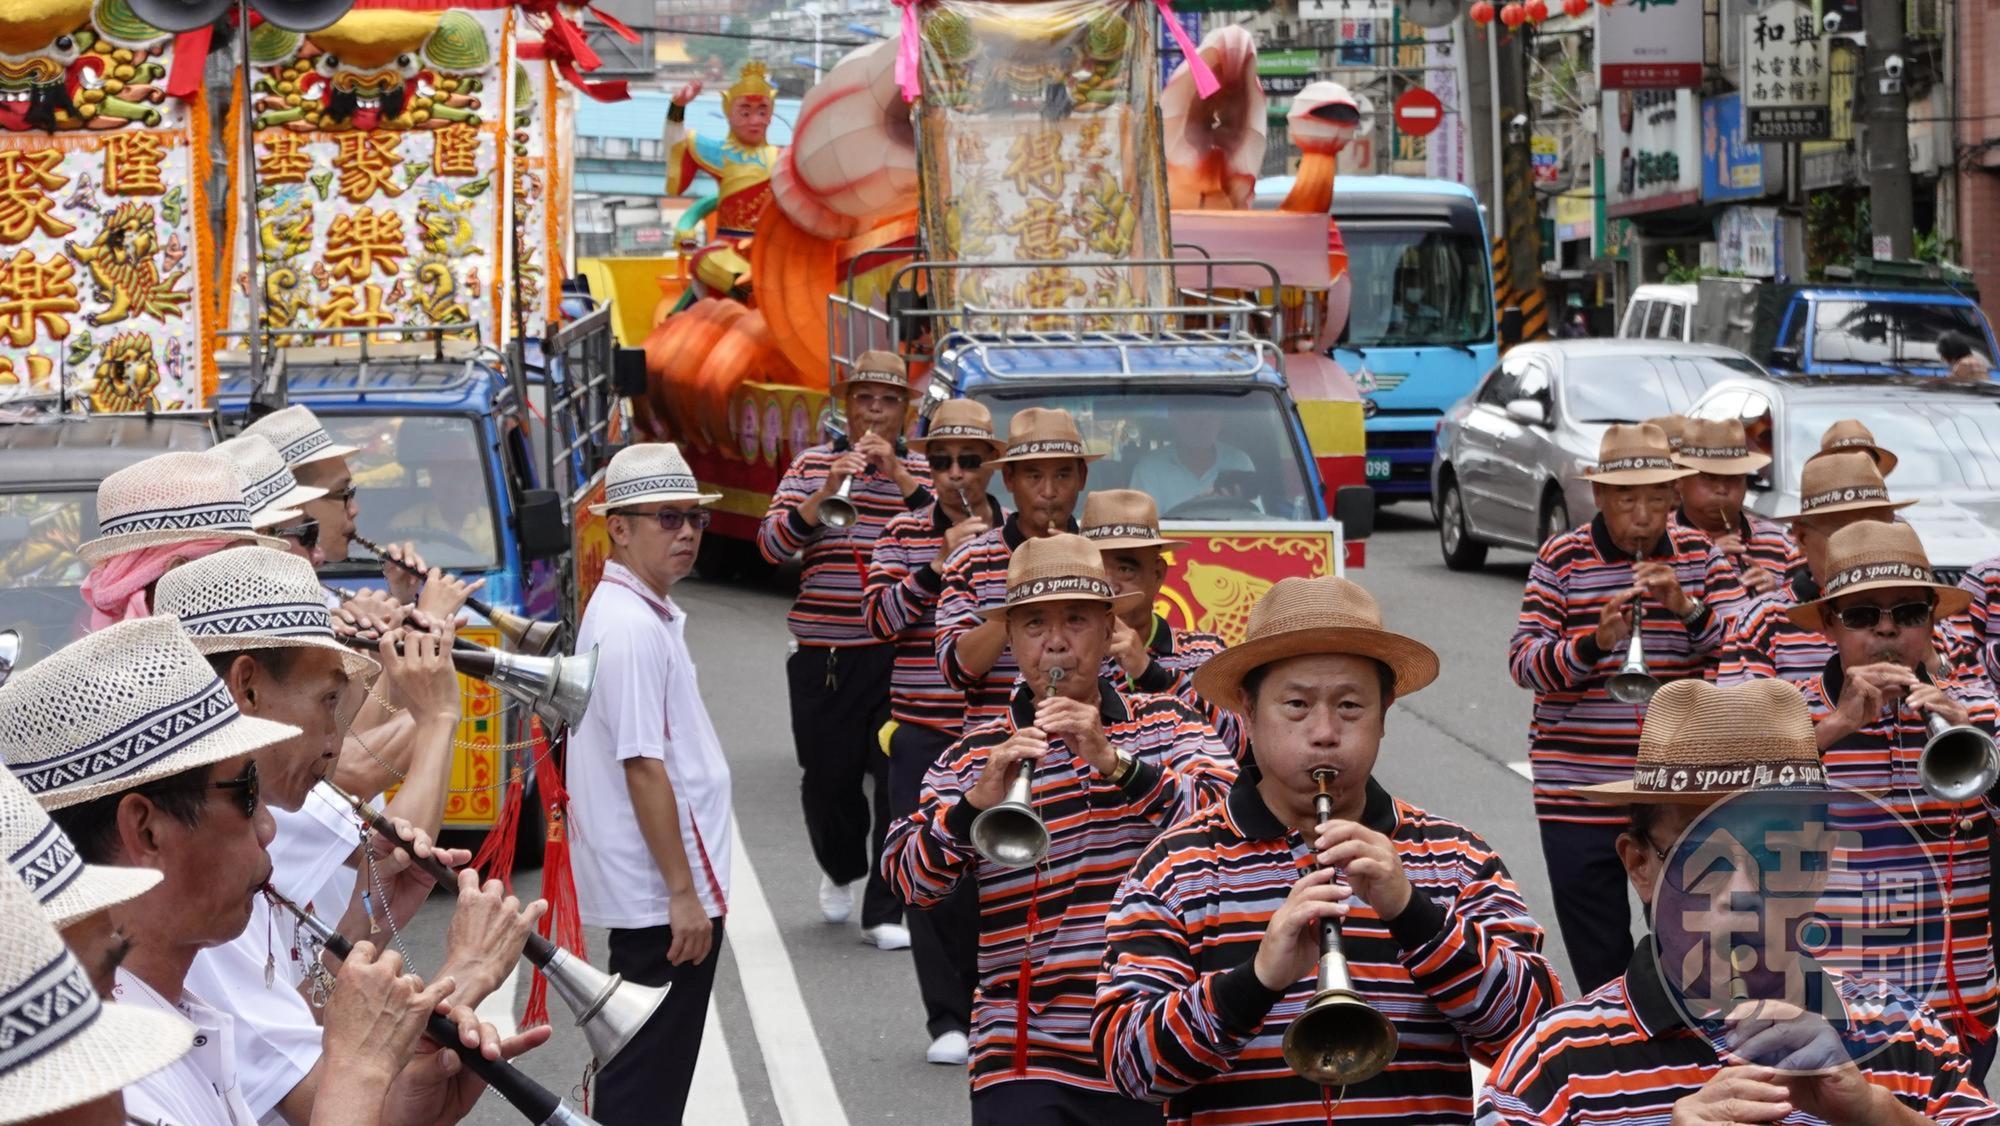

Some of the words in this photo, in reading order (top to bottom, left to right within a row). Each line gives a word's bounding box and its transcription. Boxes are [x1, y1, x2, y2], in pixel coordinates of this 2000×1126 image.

[1752, 56, 1822, 77] 水電裝修
[258, 134, 312, 185] 基
[433, 121, 480, 177] 隆
[102, 131, 167, 197] 隆
[316, 130, 409, 346] 聚樂社
[1126, 526, 1146, 537] sport
[1865, 564, 1899, 578] sport
[1047, 577, 1079, 592] sport
[1694, 765, 1751, 790] sport
